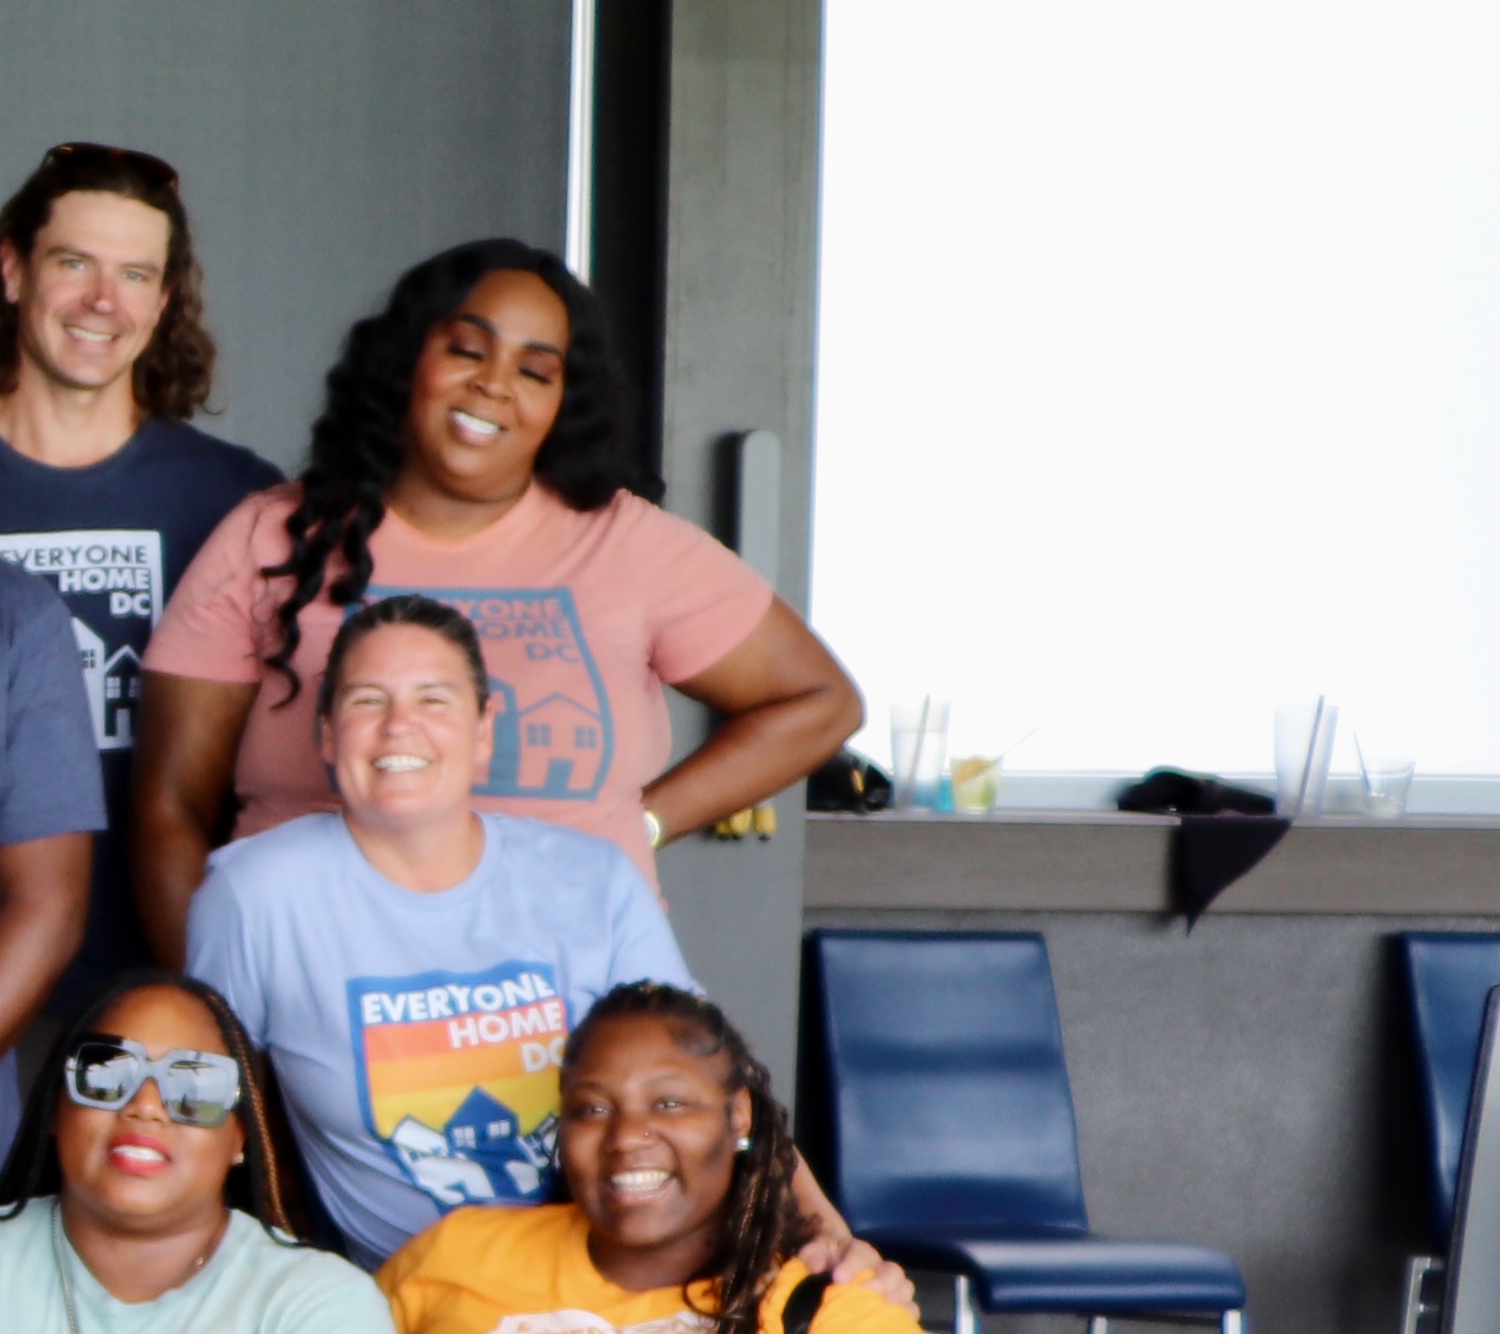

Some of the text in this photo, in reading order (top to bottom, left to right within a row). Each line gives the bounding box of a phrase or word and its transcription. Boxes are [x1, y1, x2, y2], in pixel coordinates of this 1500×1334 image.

[59, 568, 150, 592] HOME
[109, 591, 150, 615] DC
[525, 642, 579, 663] DC
[361, 971, 556, 1025] EVERYONE
[450, 1002, 563, 1049] HOME
[521, 1035, 567, 1073] DC
